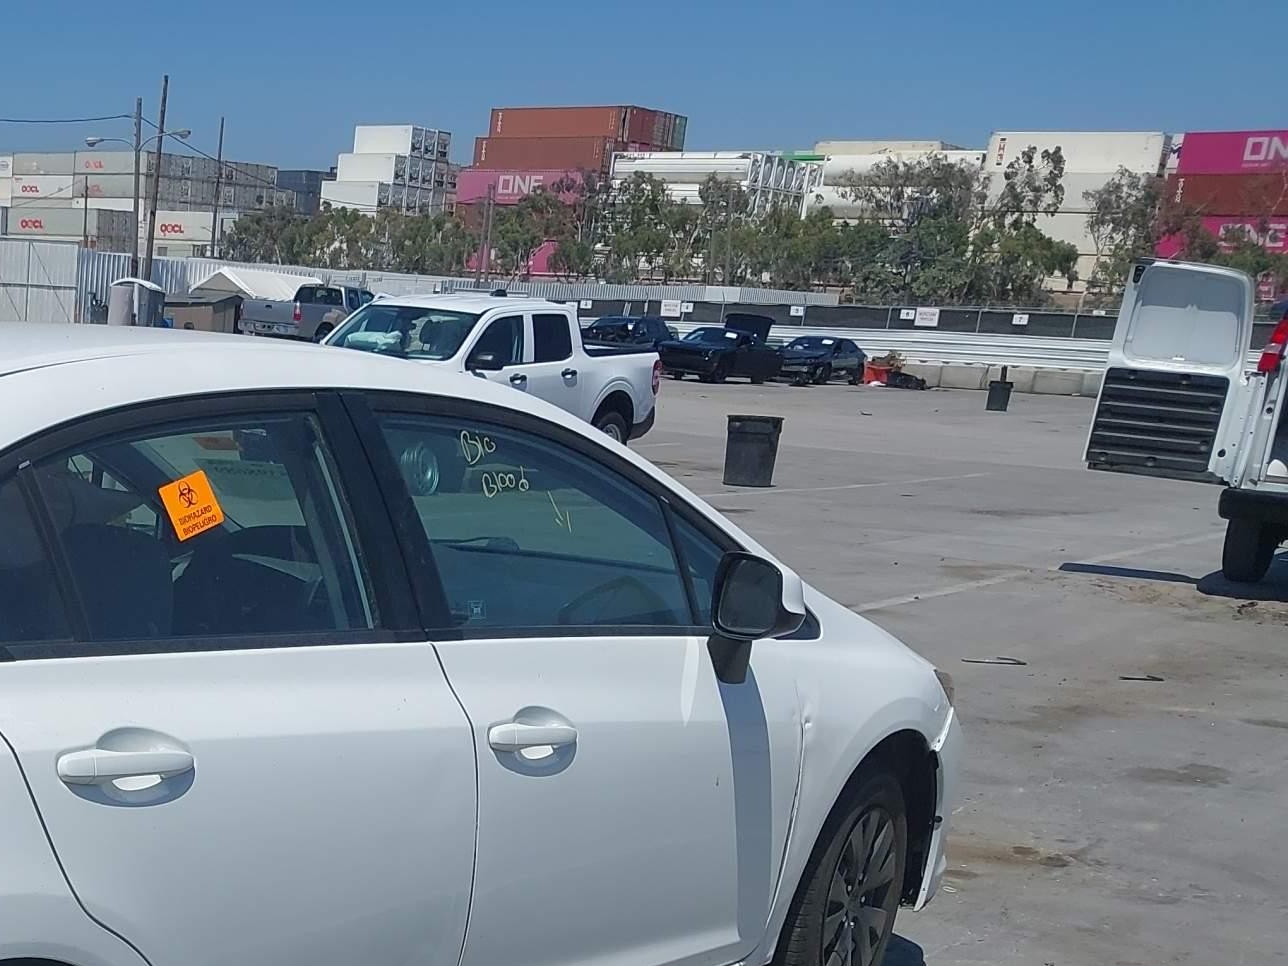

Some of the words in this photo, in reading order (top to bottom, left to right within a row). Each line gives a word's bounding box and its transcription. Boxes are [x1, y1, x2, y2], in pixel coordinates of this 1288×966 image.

[21, 185, 39, 193] OOCL
[497, 175, 544, 194] ONE
[20, 219, 44, 229] OOCL
[179, 505, 213, 525] BIOHAZARD
[182, 514, 217, 536] BIOPELIGRO
